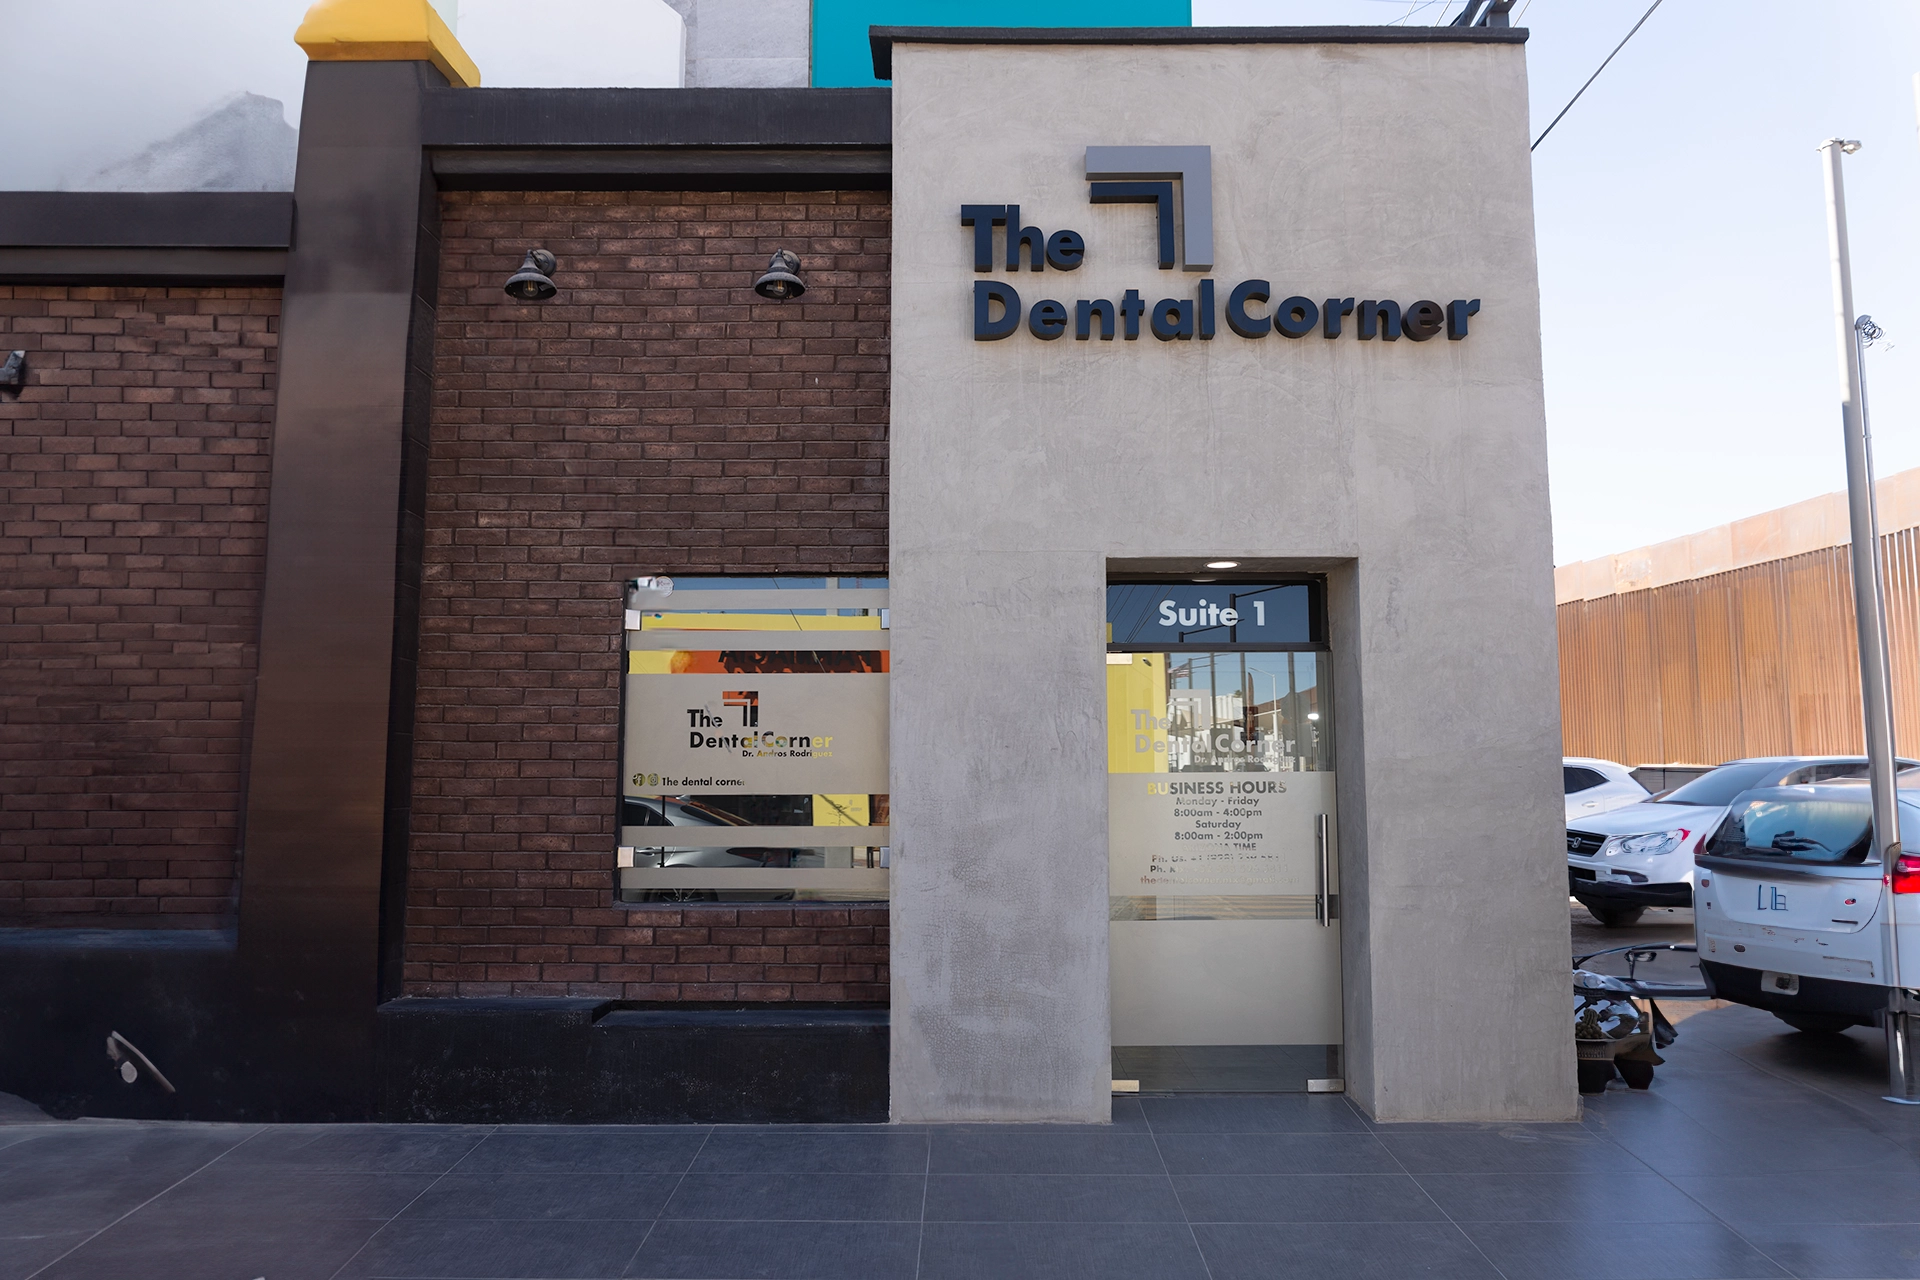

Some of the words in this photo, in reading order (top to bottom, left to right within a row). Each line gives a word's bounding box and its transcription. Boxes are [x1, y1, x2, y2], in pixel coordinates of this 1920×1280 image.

[961, 204, 1085, 272] The
[973, 279, 1215, 341] Dental
[1225, 279, 1481, 341] Corner
[1158, 598, 1239, 626] Suite
[1253, 601, 1265, 626] 1
[687, 709, 723, 727] The
[1131, 709, 1171, 730] The
[690, 731, 758, 748] Dental
[762, 731, 833, 748] Corner
[1135, 733, 1211, 753] Dental
[1215, 734, 1296, 753] Corner
[1194, 755, 1207, 763] Dr.
[662, 777, 679, 786] The
[682, 777, 712, 786] dental
[1147, 781, 1224, 795] BUSINESS
[1230, 781, 1287, 794] HOURS
[1176, 797, 1217, 807] Monday
[1228, 796, 1259, 807] Friday
[1174, 808, 1213, 817] 8:00am
[1223, 808, 1262, 818] 4:00pm
[1195, 820, 1241, 830] Saturday
[1174, 831, 1214, 840] 8:00am
[1224, 831, 1263, 841] 2:00pm
[1233, 843, 1257, 851] TIME
